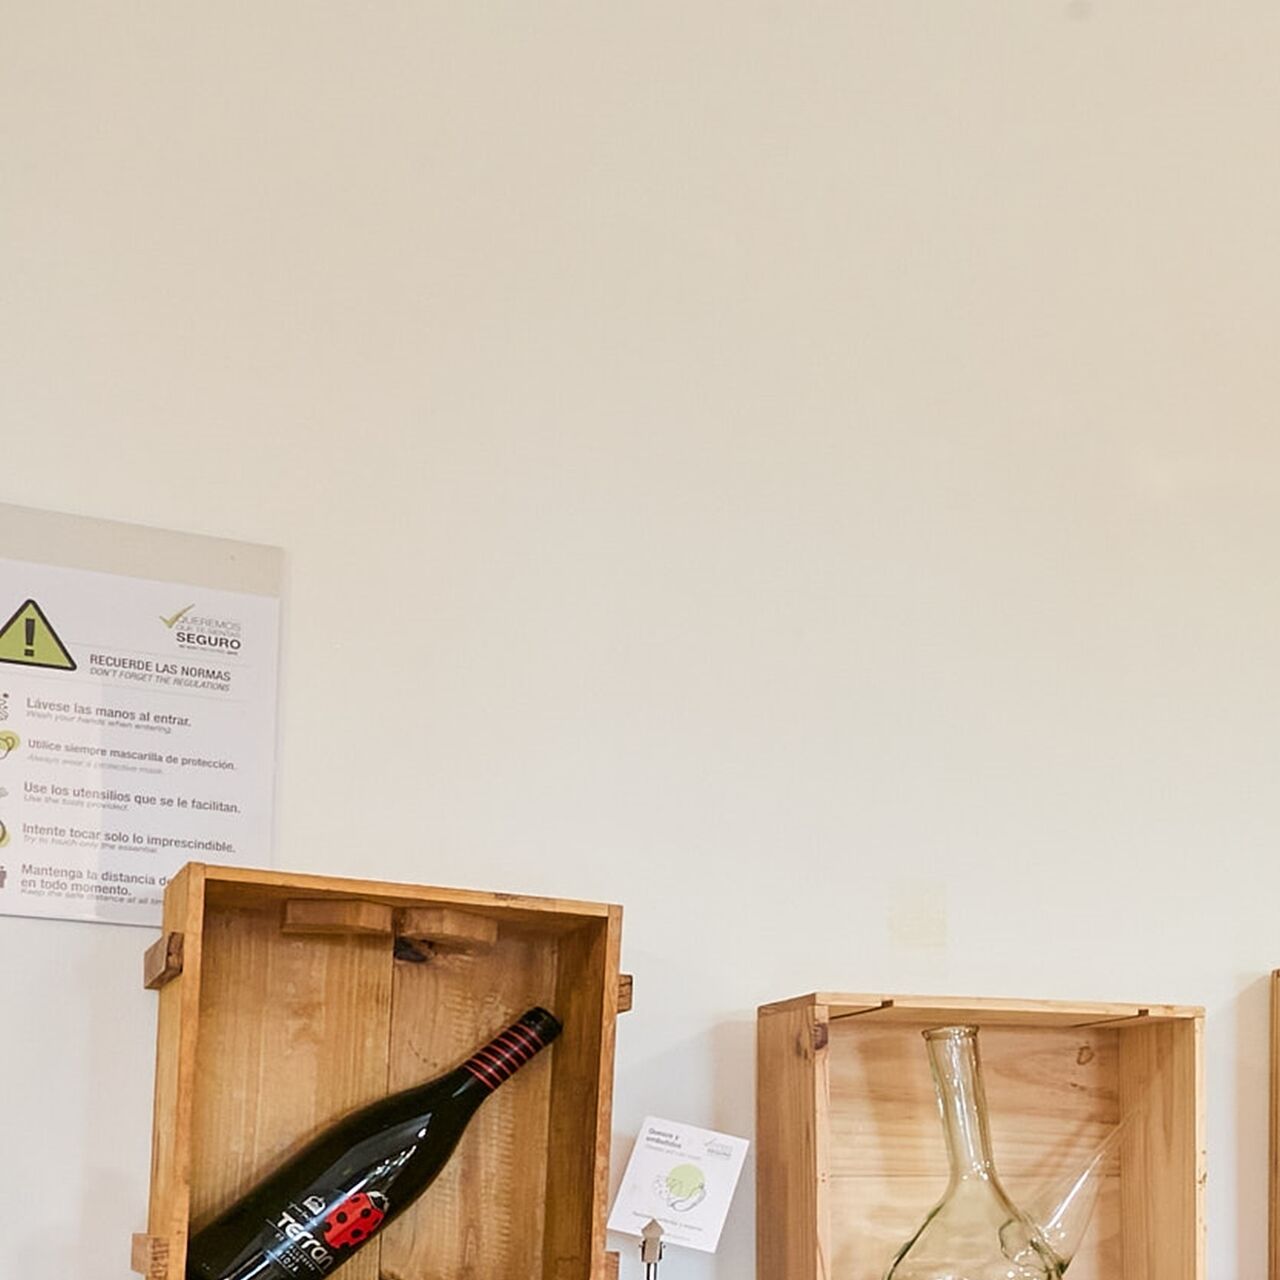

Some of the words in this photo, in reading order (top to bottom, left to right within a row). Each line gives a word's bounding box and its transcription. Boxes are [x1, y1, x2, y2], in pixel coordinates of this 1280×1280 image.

[176, 631, 242, 650] SEGURO
[90, 654, 153, 672] RECUERDE
[156, 663, 178, 675] LAS
[181, 666, 231, 682] NORMAS
[119, 671, 153, 683] FORGET
[155, 675, 170, 684] THE
[173, 677, 231, 692] REGULATIONS
[26, 697, 70, 713] Lávese
[74, 704, 92, 715] las
[95, 707, 135, 720] manos
[139, 709, 150, 722] al
[153, 713, 192, 727] entrar.
[28, 739, 62, 751] Utilice
[65, 743, 107, 757] siempre
[110, 748, 163, 762] mascarilla
[166, 754, 179, 764] de
[24, 781, 47, 794] Use
[51, 784, 69, 796] los
[73, 787, 131, 803] utensilios
[134, 794, 157, 808] que
[160, 795, 174, 807] se
[177, 797, 187, 808] le
[191, 799, 241, 814] facilitan.
[22, 823, 66, 837] Intente
[69, 826, 100, 840] tocar
[104, 831, 129, 843] solo
[133, 833, 143, 844] lo
[147, 834, 236, 853] imprescindible.
[21, 864, 83, 881] Mantenga
[87, 868, 98, 881] la
[101, 872, 154, 885] distancia
[21, 879, 36, 889] en
[40, 878, 67, 891] todo
[71, 882, 132, 897] momento.
